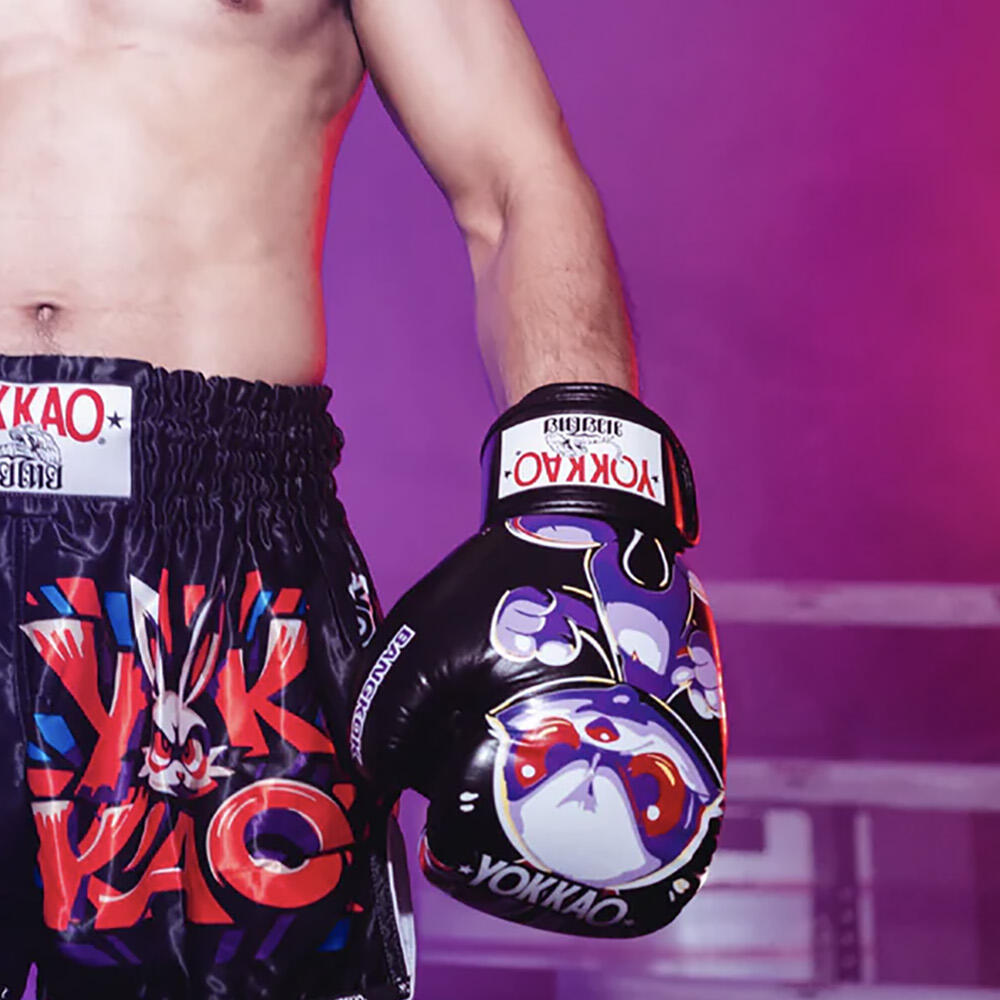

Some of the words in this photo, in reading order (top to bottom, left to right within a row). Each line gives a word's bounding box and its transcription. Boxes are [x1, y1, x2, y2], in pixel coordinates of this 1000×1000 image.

[514, 451, 656, 498] YOKKAO
[350, 624, 416, 766] BANGKOK
[470, 853, 628, 926] YOKKAO
